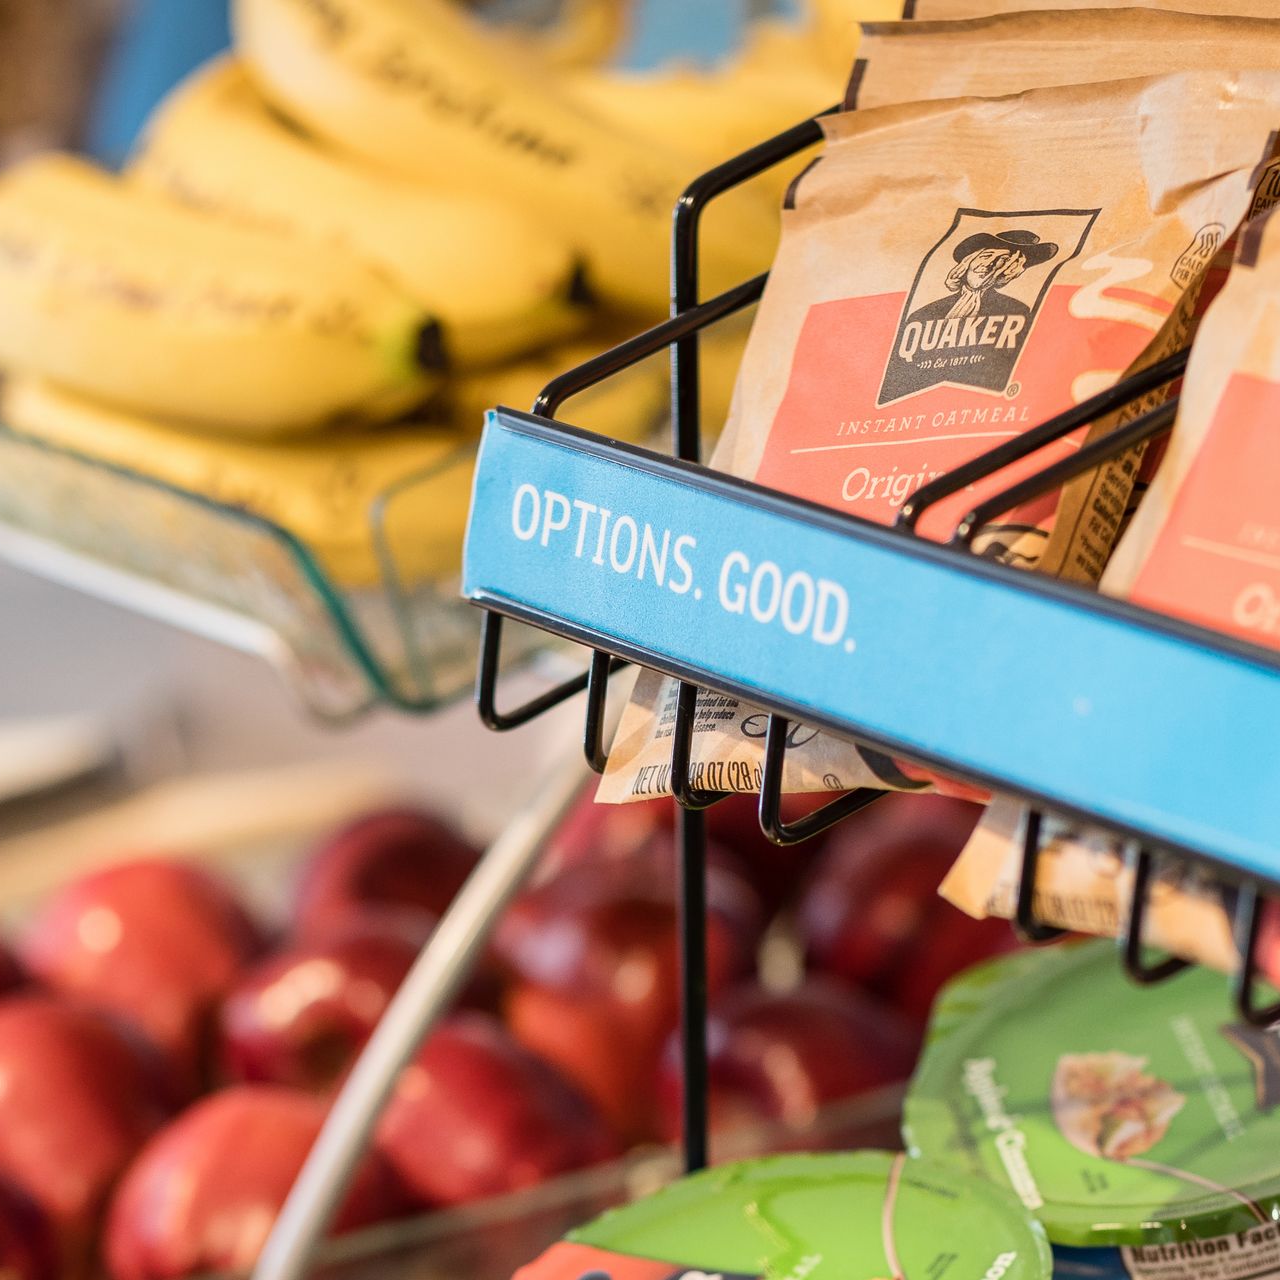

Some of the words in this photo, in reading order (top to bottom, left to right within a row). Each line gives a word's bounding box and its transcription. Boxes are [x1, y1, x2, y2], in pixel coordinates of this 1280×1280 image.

[898, 314, 1025, 362] QUAKER
[950, 355, 969, 367] 1877
[836, 414, 926, 438] INSTANT
[931, 404, 1031, 430] OATMEAL
[510, 483, 702, 600] OPTIONS.
[719, 551, 857, 653] GOOD.
[632, 765, 656, 795] NET
[707, 762, 724, 791] OZ
[727, 760, 753, 791] (28
[1132, 1237, 1230, 1264] Nutrition
